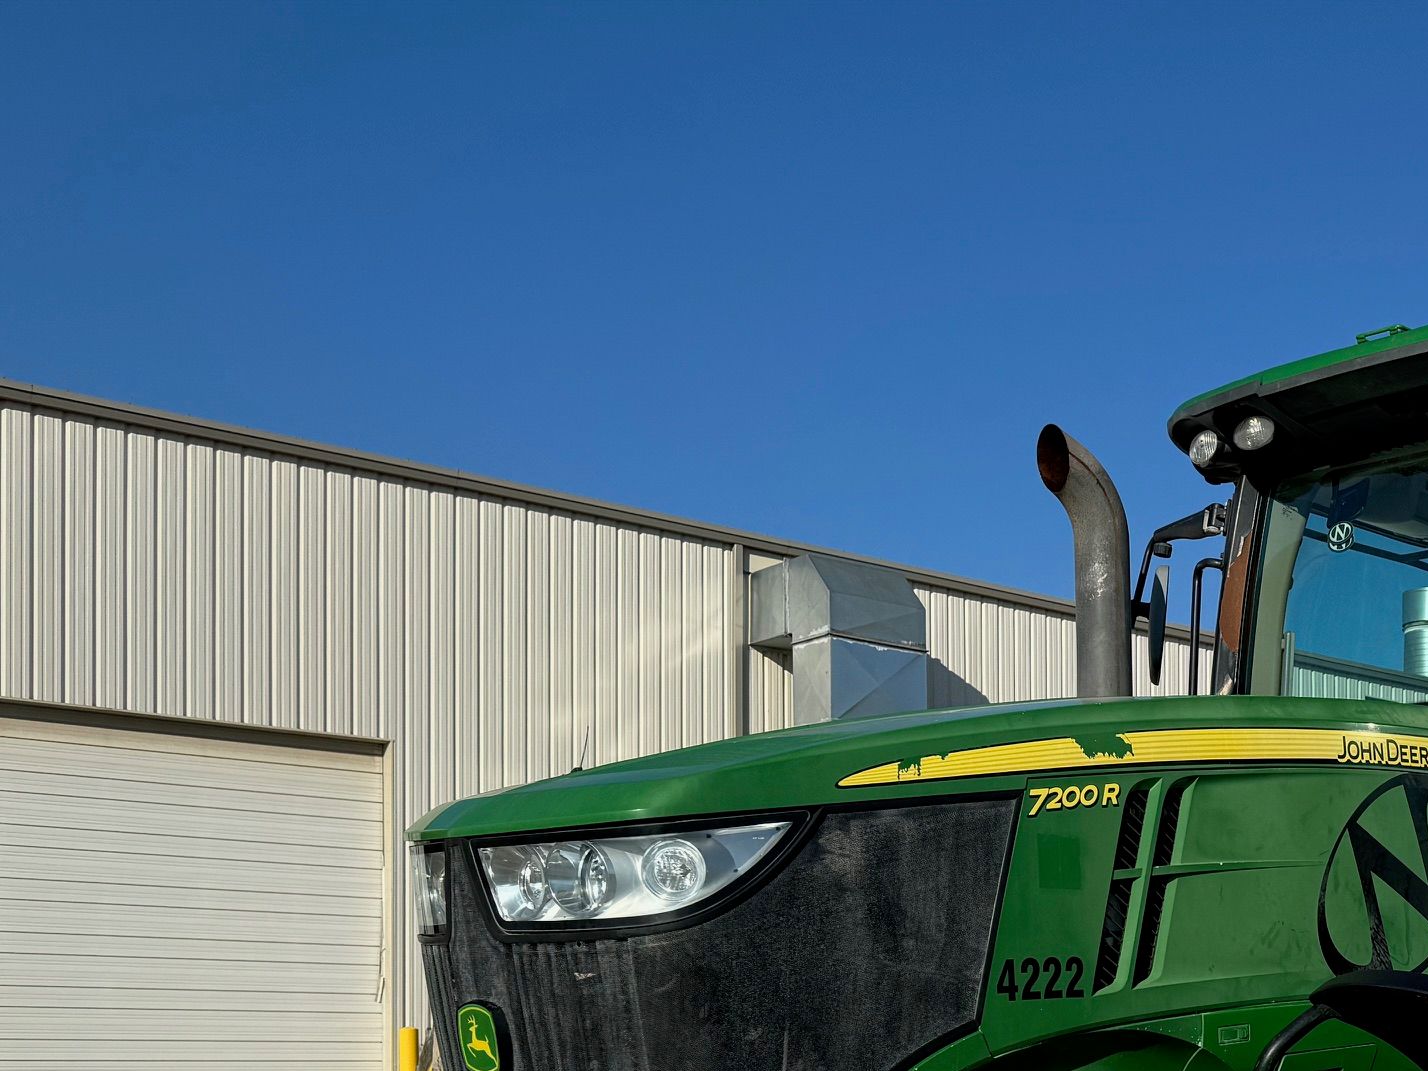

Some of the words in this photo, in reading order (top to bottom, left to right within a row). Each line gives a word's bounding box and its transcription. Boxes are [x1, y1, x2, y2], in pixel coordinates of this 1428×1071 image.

[1337, 735, 1384, 762] JOHN
[1027, 784, 1099, 817] 7200
[1101, 782, 1121, 807] R
[997, 956, 1085, 1002] 4222
